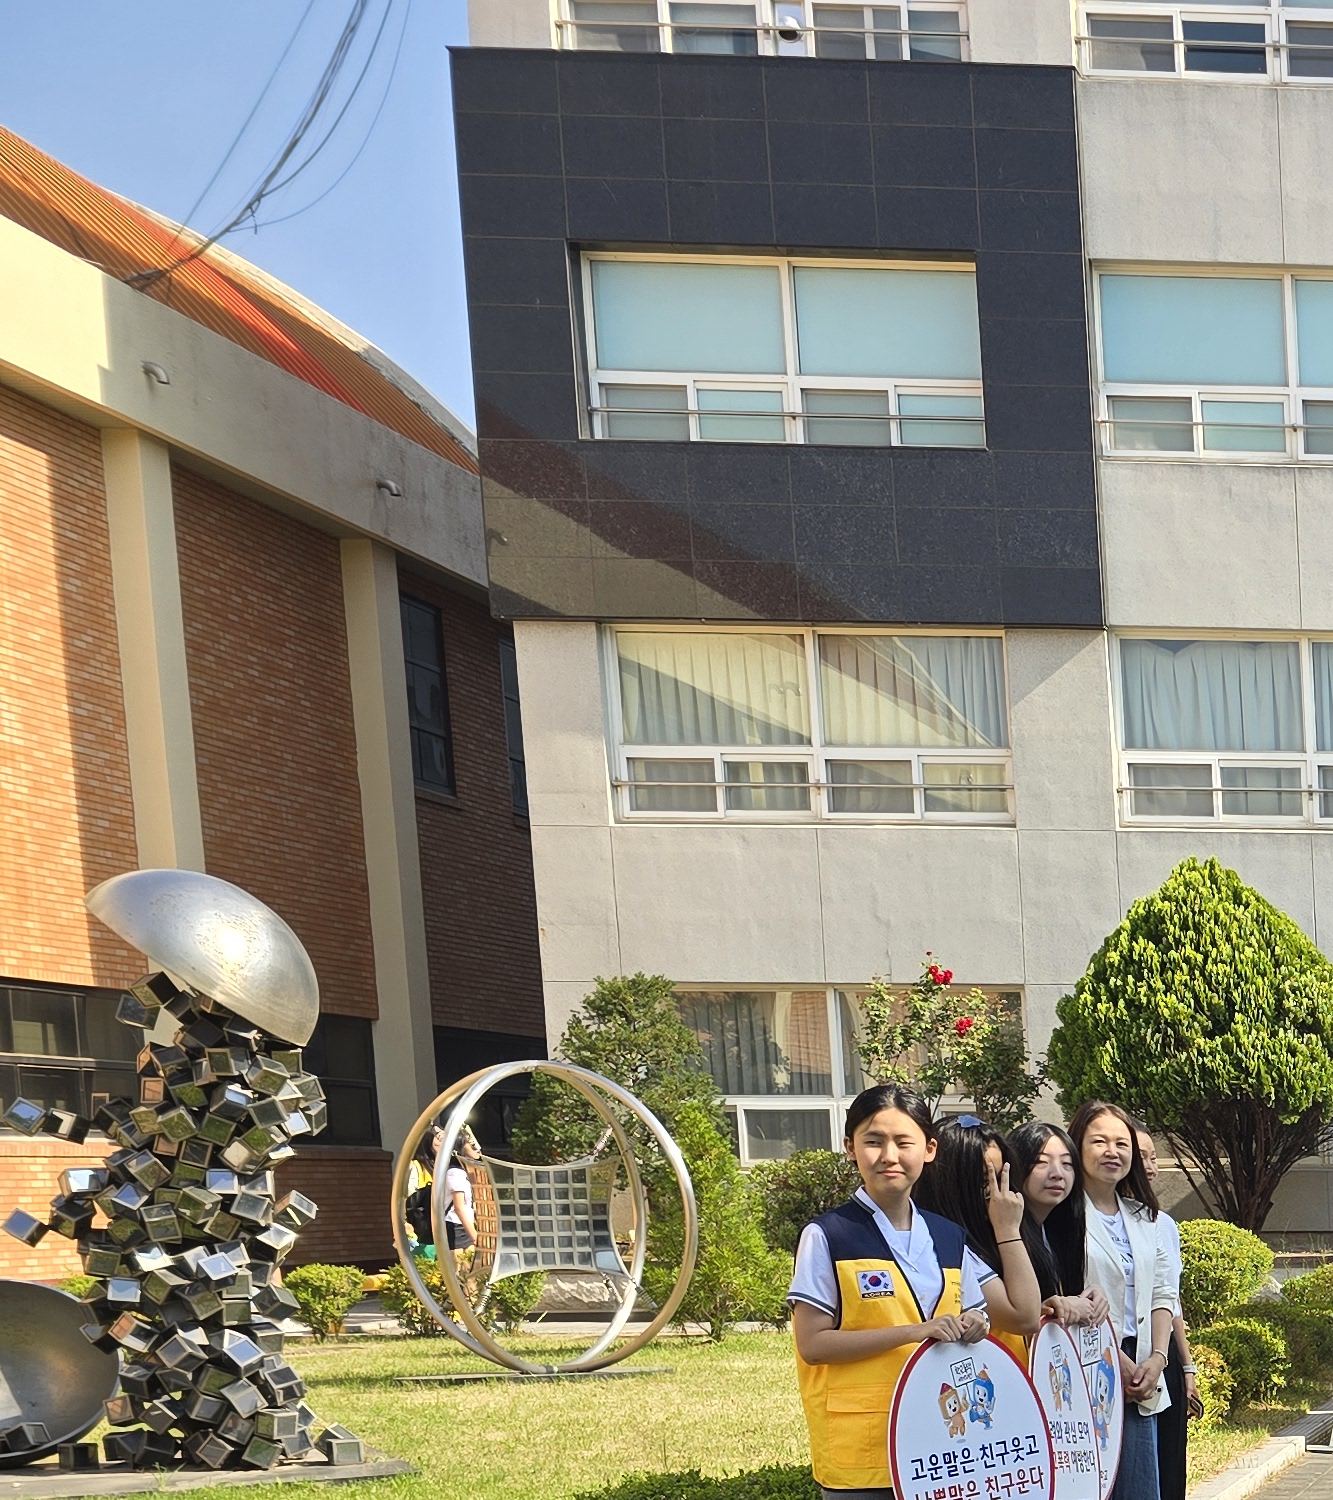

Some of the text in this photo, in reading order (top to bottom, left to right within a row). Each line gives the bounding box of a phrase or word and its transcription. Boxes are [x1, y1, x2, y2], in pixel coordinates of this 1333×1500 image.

[864, 1291, 894, 1299] KOREA
[1064, 1421, 1078, 1445] 관심
[1078, 1422, 1092, 1444] 모여
[910, 1434, 1040, 1482] 고운말은 친구웃고
[1054, 1449, 1097, 1474] 폭력 예방한다
